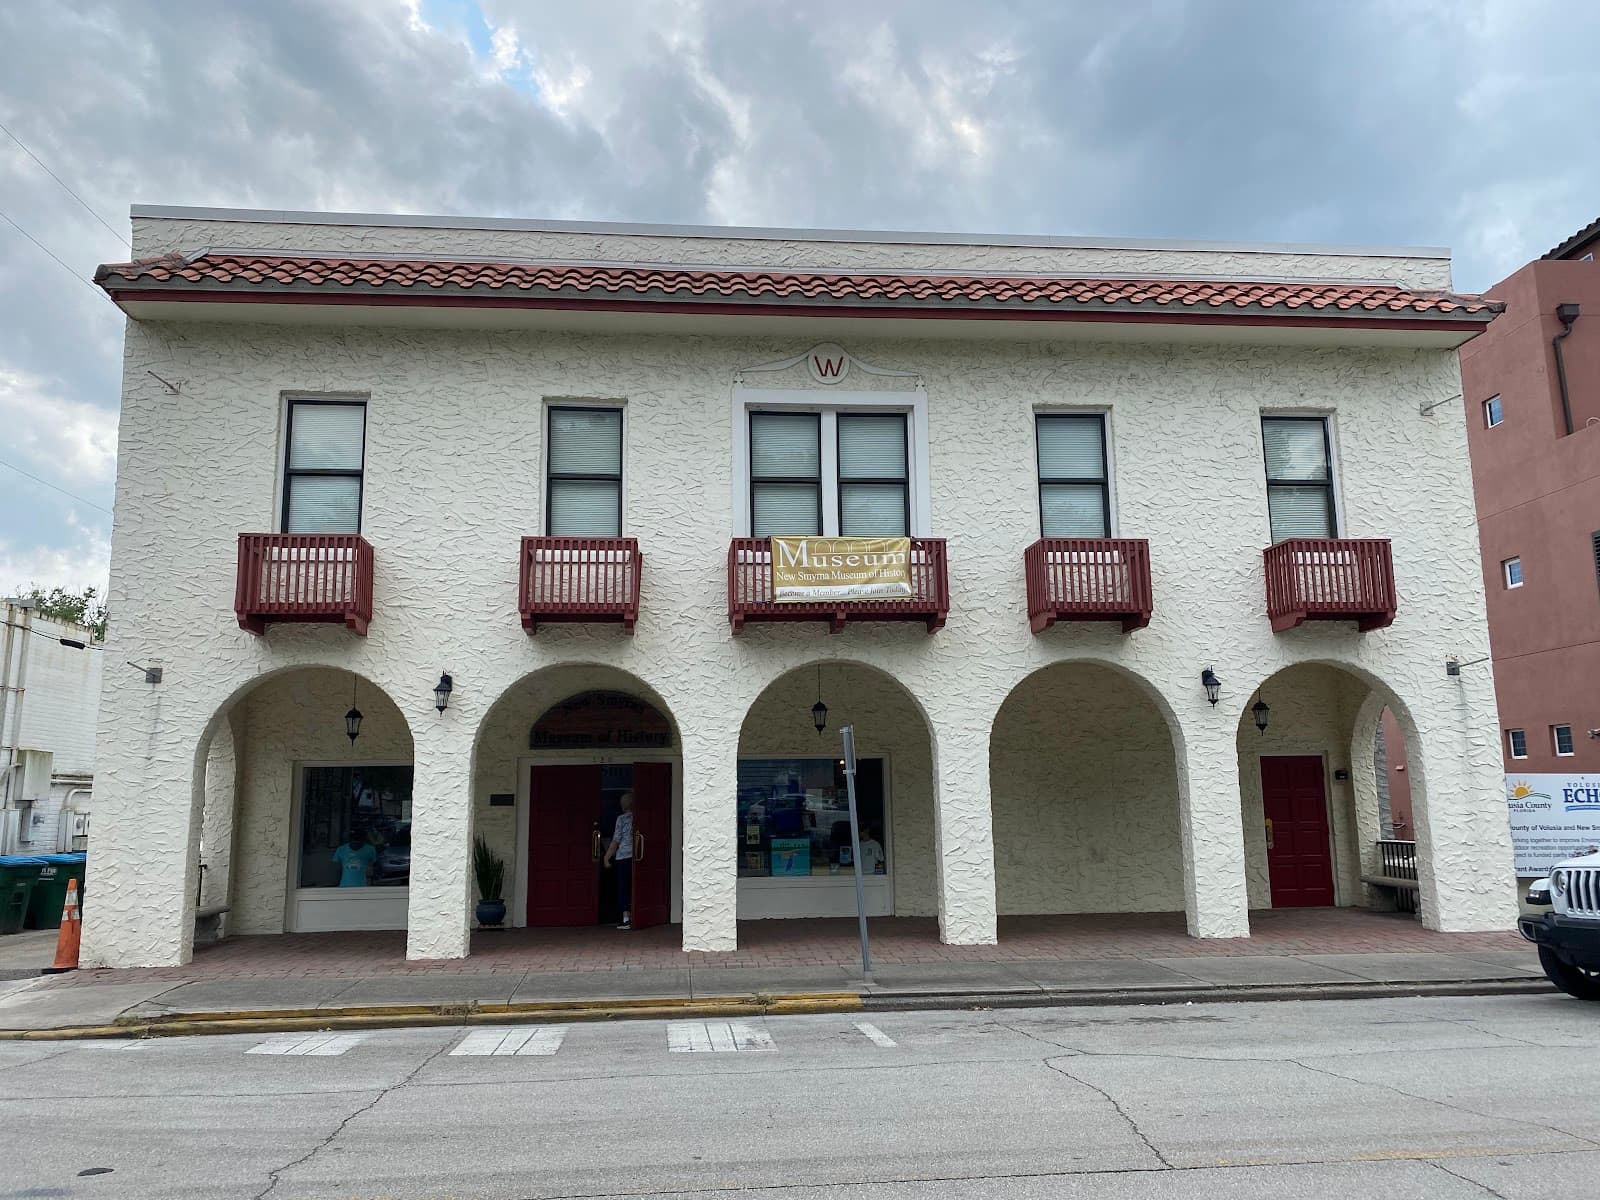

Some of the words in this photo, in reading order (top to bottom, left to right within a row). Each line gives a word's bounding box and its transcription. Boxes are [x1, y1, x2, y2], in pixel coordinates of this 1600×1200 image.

[814, 355, 844, 377] W
[775, 539, 906, 568] Museum
[776, 571, 796, 581] New
[831, 570, 867, 581] Museum
[868, 568, 877, 578] of
[1562, 788, 1600, 803] ECH
[1525, 801, 1552, 811] County
[1511, 824, 1530, 832] ounty
